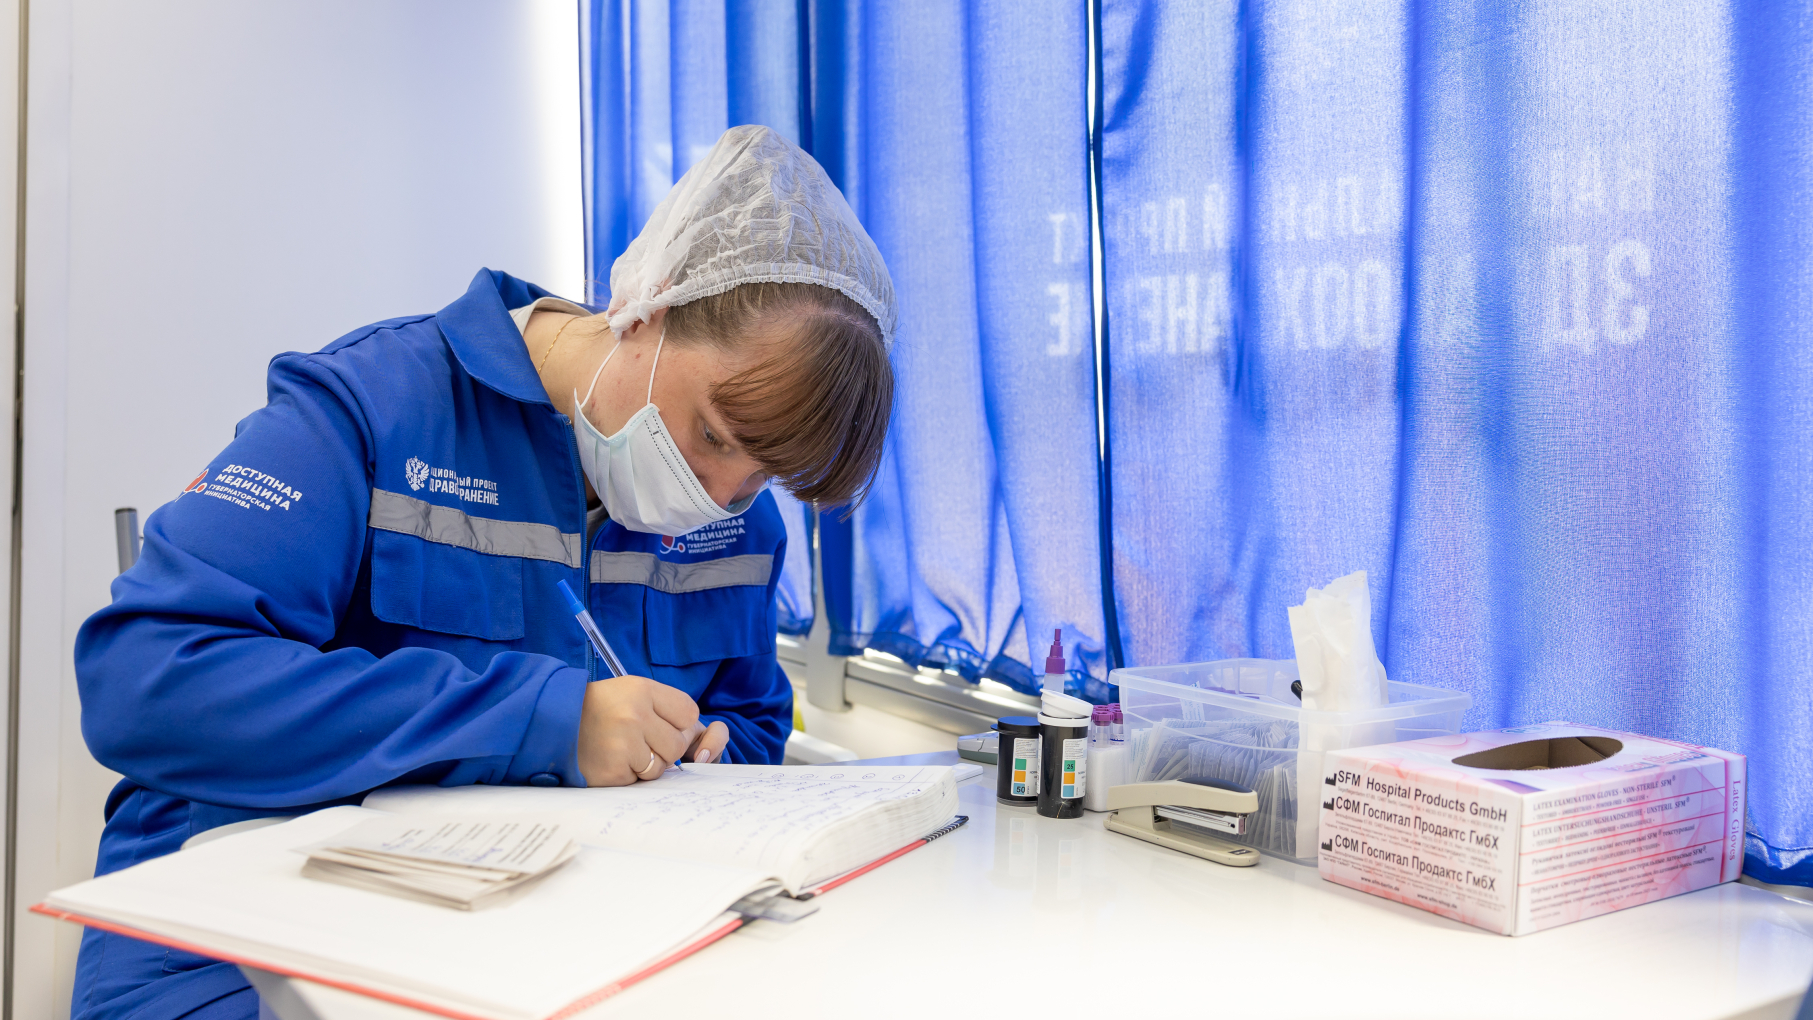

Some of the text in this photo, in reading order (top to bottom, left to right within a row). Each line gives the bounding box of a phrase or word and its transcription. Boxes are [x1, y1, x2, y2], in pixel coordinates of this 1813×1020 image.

[204, 490, 251, 510] ИНИЦИАТИВА
[208, 484, 271, 511] ГУБЕРНАТОРСКАЯ
[215, 474, 291, 511] МЕДИЦИНА
[222, 464, 303, 502] ДОСТУПНАЯ
[473, 478, 498, 491] ПРОЕКТ
[686, 527, 746, 541] МЕДИЦИНА
[687, 537, 738, 549] ГУБЕРНАТОРСКАЯ
[688, 544, 727, 554] ИНИЦИАТИВА
[1337, 770, 1360, 788] SFM
[1366, 776, 1410, 802] Hospital
[1414, 788, 1465, 812] Products
[1469, 801, 1507, 822] GmbH
[1533, 800, 1552, 811] LATEX
[1554, 792, 1595, 807] EXAMINATION
[1597, 788, 1618, 799] GLOVES
[1622, 780, 1658, 794] NON-STERILE
[1336, 796, 1359, 814] СФМ
[1362, 803, 1410, 827] Госпитал
[1413, 816, 1465, 844] Продактс
[1469, 830, 1499, 850] ГмбХ
[1532, 826, 1552, 838] LATEX
[1646, 801, 1672, 814] UNSTERIL
[1729, 780, 1741, 861] Latex Gloves
[1335, 834, 1358, 852] СФМ
[1361, 841, 1408, 867] Госпитал
[1411, 855, 1462, 884] Продактс
[1465, 871, 1496, 892] ГмбХ
